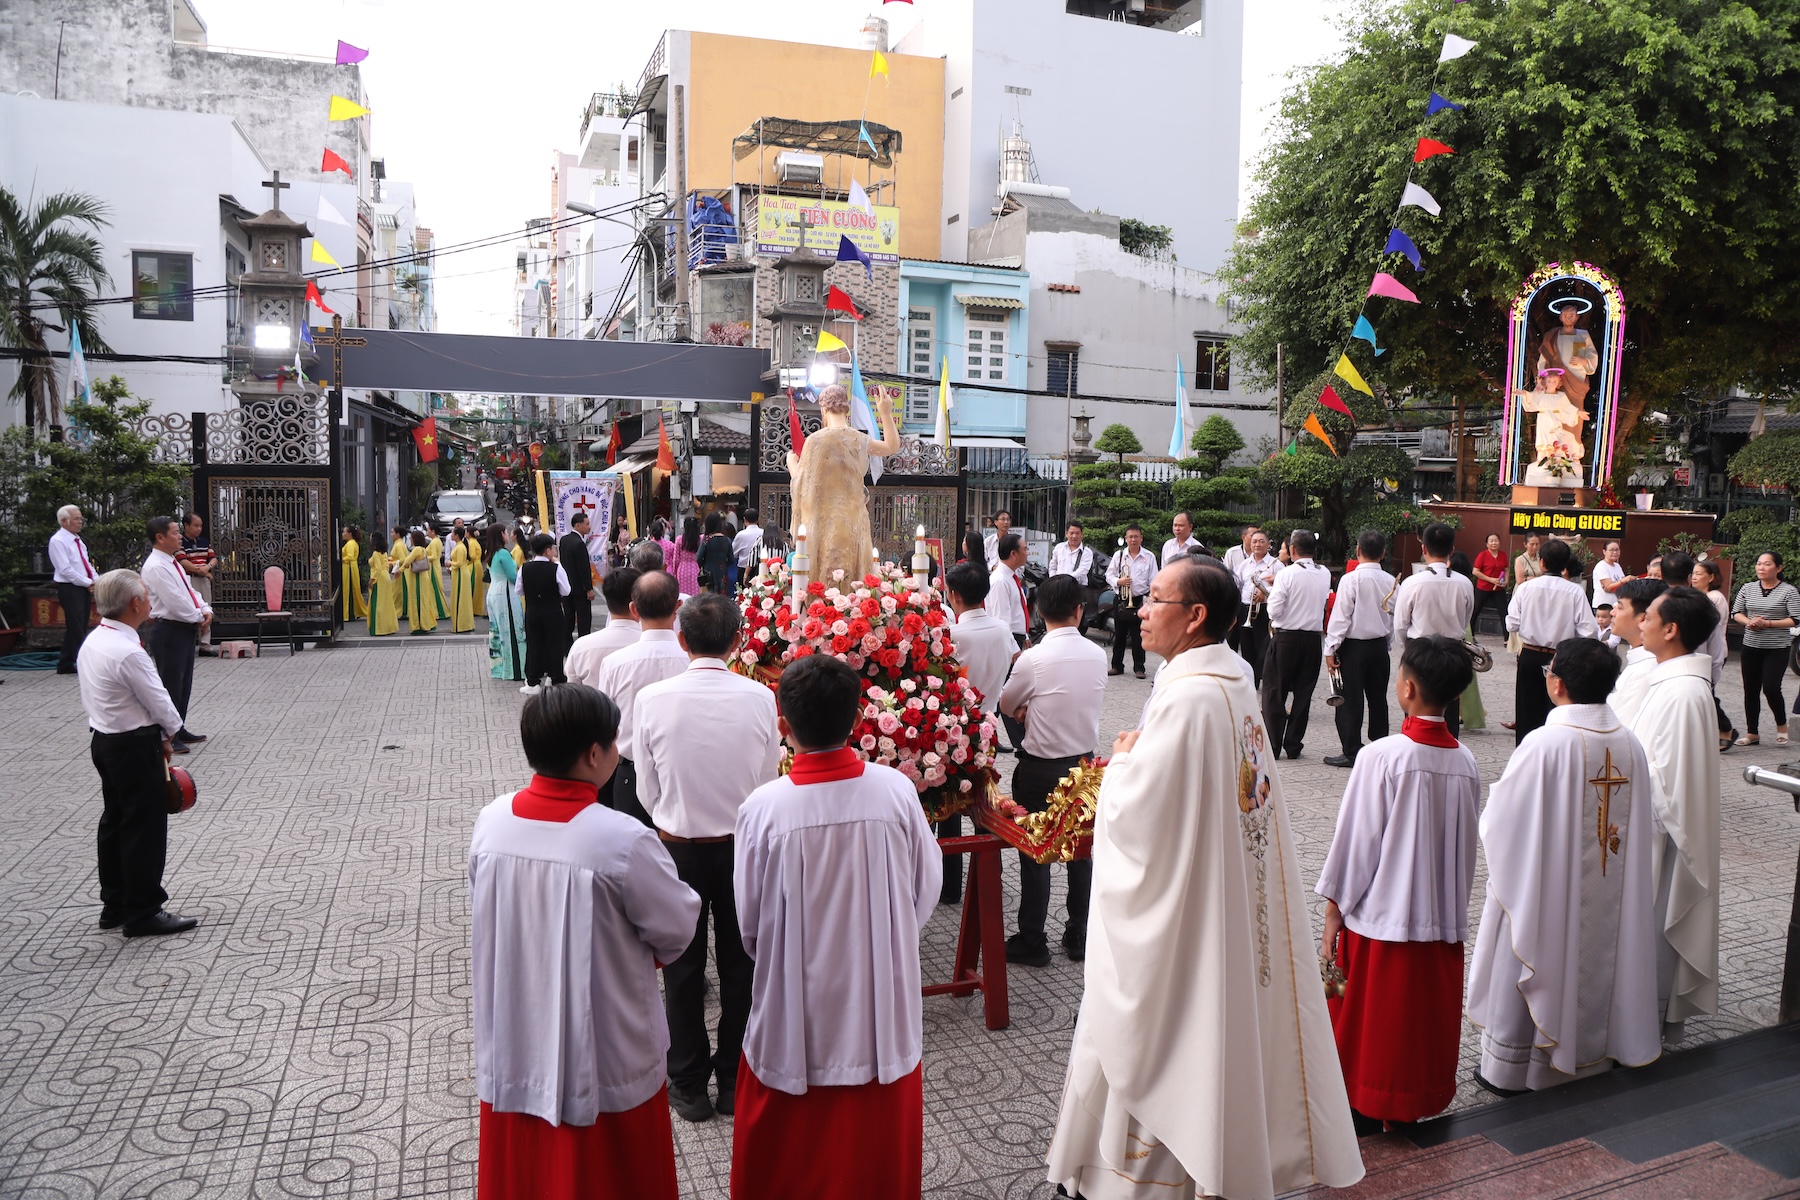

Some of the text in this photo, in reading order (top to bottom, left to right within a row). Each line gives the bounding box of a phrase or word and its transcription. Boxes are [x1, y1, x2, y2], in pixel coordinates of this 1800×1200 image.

[762, 197, 779, 209] Hoa
[833, 207, 877, 231] CƯỜNG
[1513, 511, 1623, 531] Hãy Đến Cùng GIUSE
